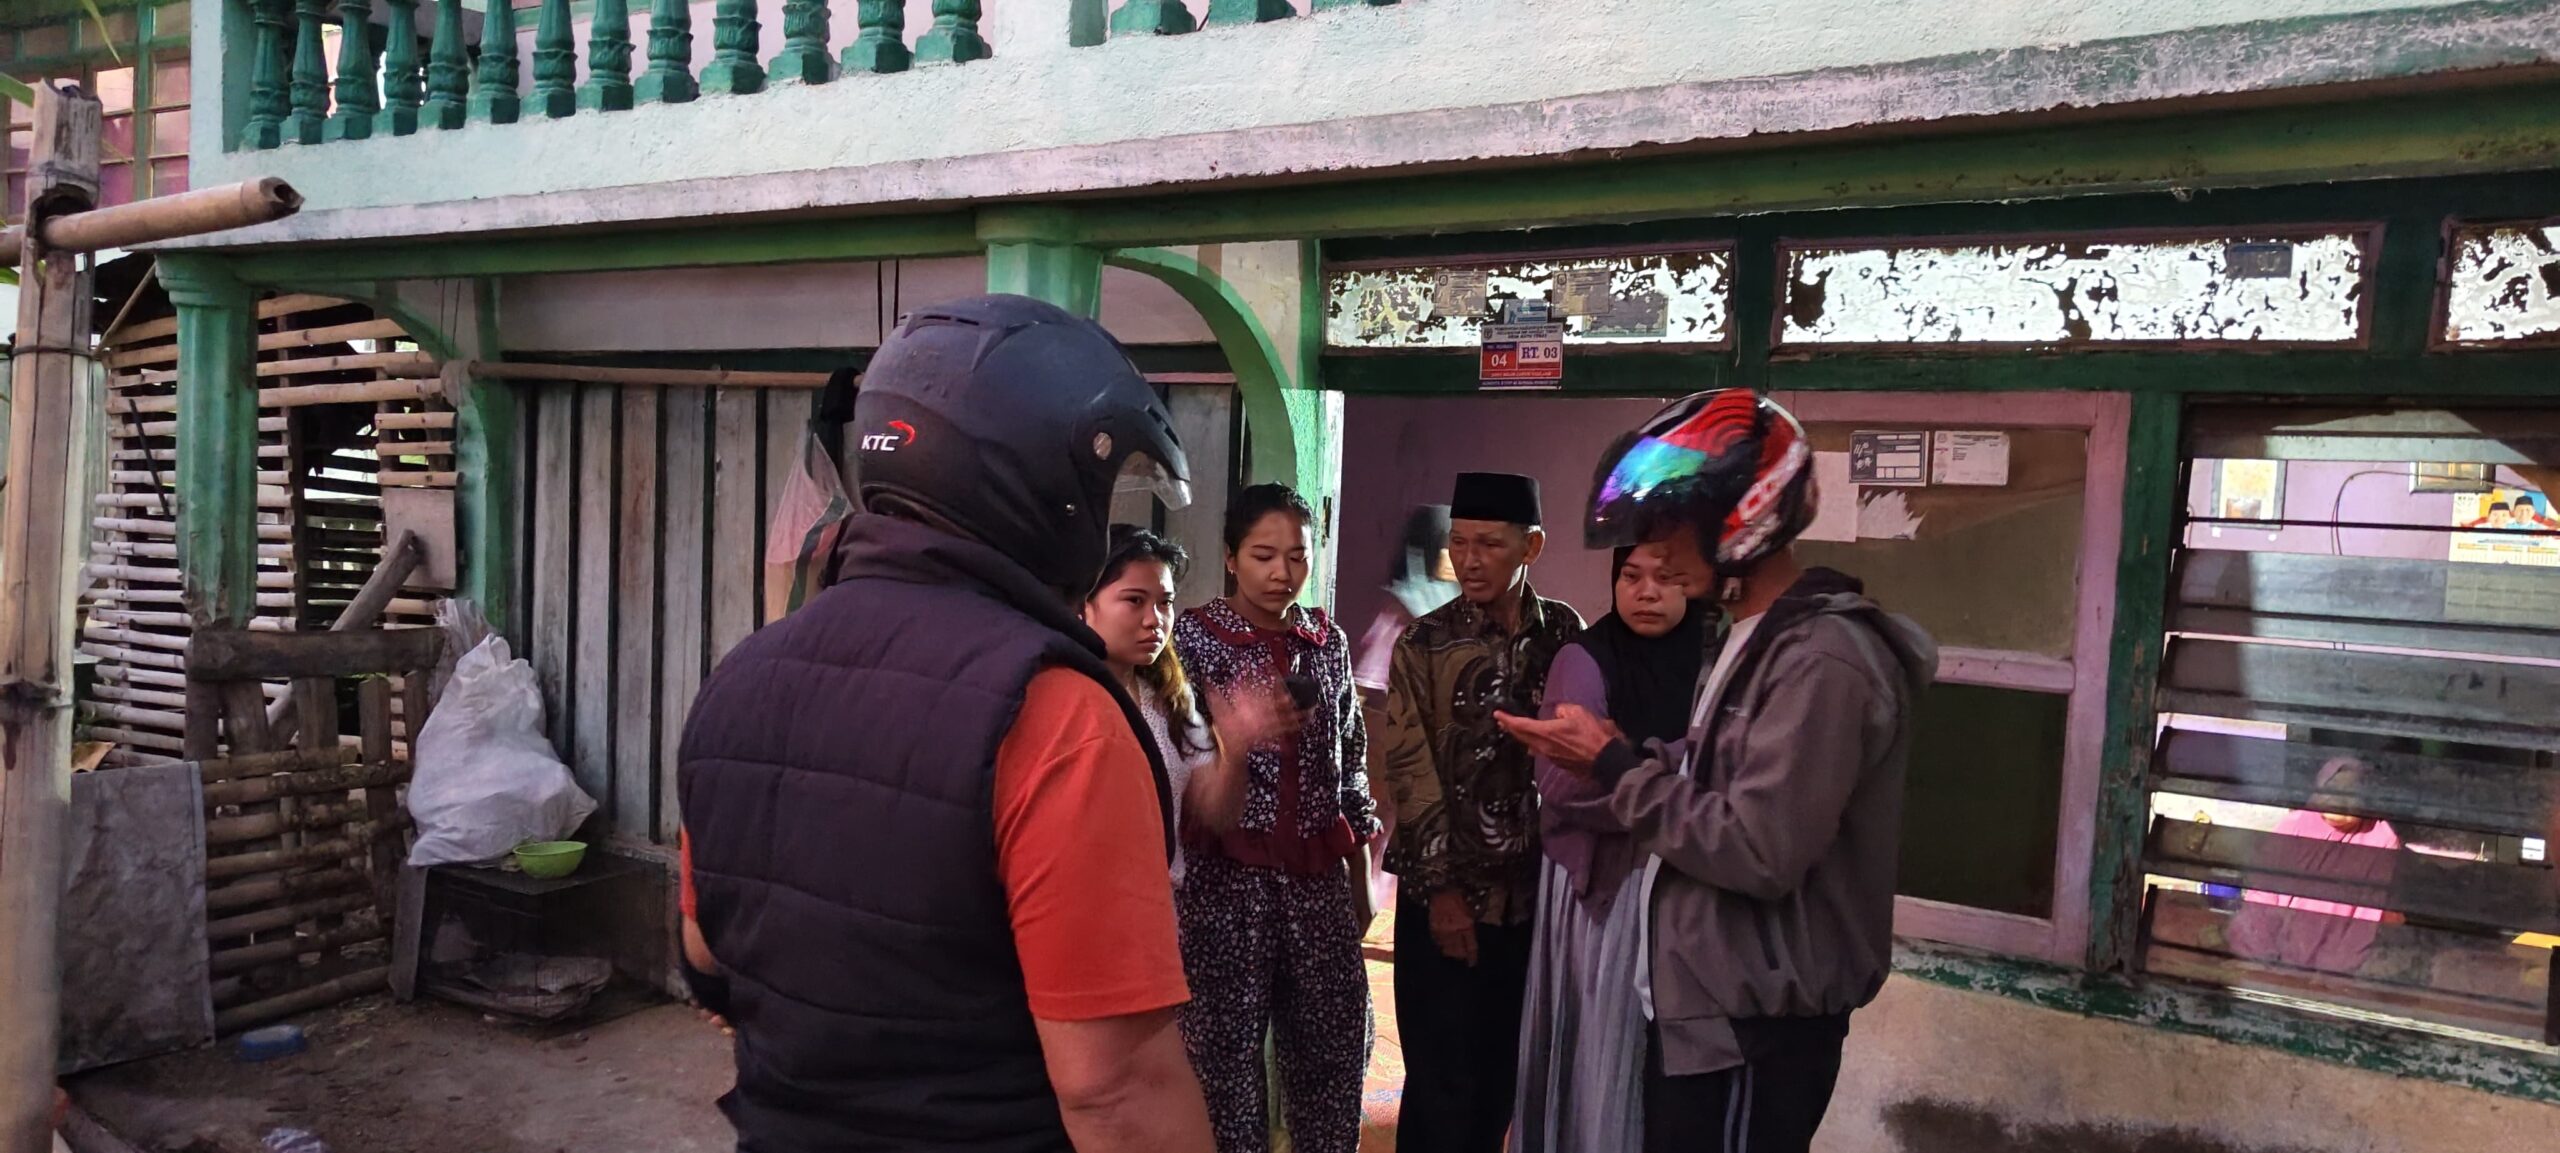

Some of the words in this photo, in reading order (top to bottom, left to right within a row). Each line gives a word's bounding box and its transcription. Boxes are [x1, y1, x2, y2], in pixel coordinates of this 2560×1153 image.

[1543, 346, 1558, 359] 03
[1491, 353, 1508, 367] 04
[861, 433, 900, 452] KTC
